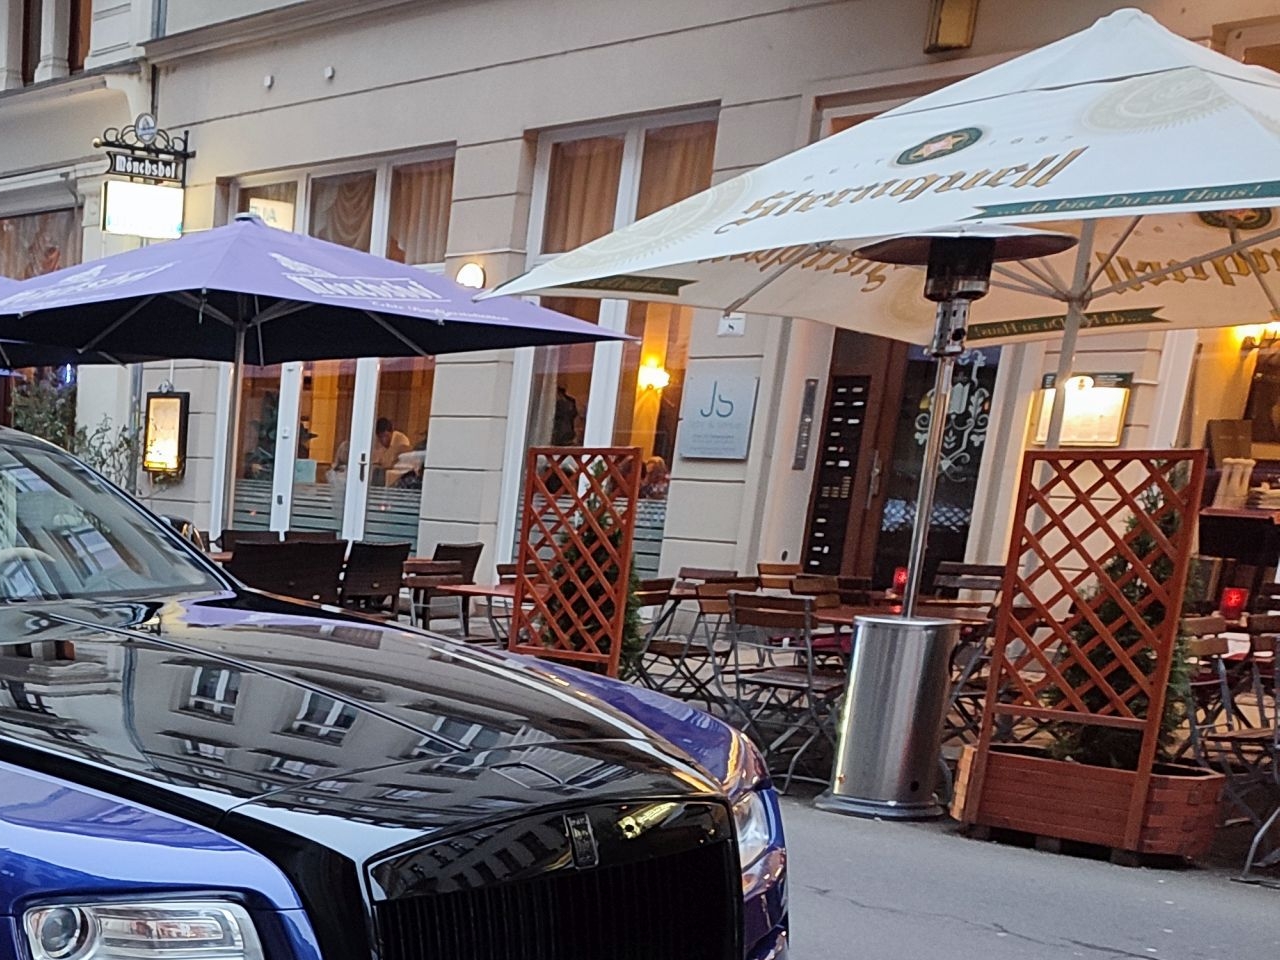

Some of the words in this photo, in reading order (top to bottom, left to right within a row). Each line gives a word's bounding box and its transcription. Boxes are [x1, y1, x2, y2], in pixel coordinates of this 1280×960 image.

[115, 154, 177, 179] Mönchshof
[713, 145, 1090, 234] Sternquell
[1055, 199, 1096, 212] bist
[1103, 195, 1141, 208] Du
[1147, 194, 1175, 205] zu
[1180, 184, 1263, 201] Haus!
